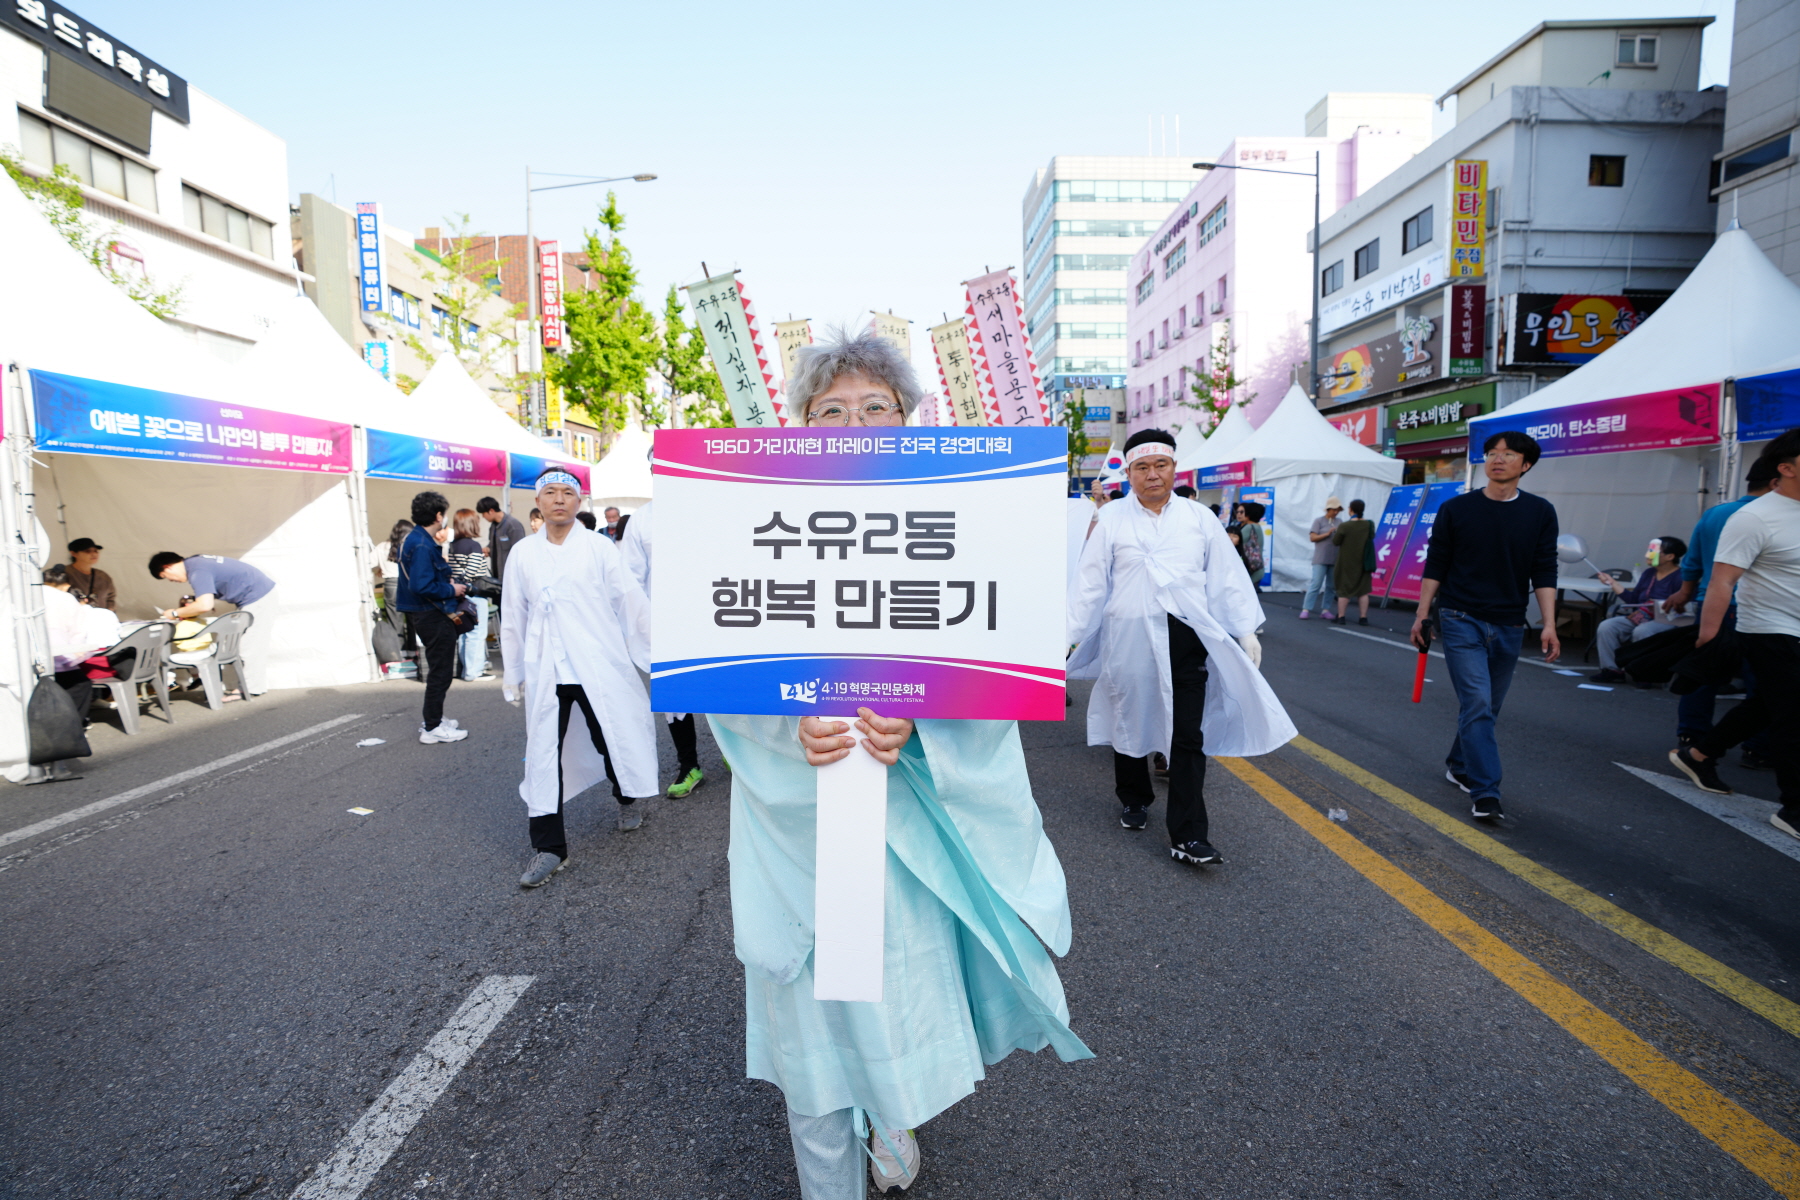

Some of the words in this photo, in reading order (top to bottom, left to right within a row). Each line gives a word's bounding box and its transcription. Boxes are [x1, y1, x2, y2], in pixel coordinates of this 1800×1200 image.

[1457, 163, 1482, 245] 비타민
[1454, 248, 1480, 263] 주점
[696, 287, 738, 313] 수유2동
[975, 282, 1010, 306] 수유2동
[1352, 290, 1374, 317] 수유
[1523, 310, 1605, 347] 무인도
[714, 311, 766, 428] 적십자봉
[986, 302, 1035, 427] 새마을문고
[947, 349, 981, 427] 통장협
[1397, 401, 1464, 430] 본죽&비빔밥
[1569, 415, 1627, 436] 탄소중립
[89, 408, 141, 437] 예쁜
[144, 415, 204, 442] 꽃으로
[205, 423, 258, 449] 나만의
[259, 430, 290, 452] 봉투
[291, 434, 333, 457] 만들자!
[704, 439, 749, 454] 1960
[753, 438, 822, 455] 거리재현
[826, 437, 896, 455] 퍼레이드
[900, 437, 936, 454] 전국
[939, 436, 1012, 455] 경연대회
[428, 455, 455, 472] 언제나
[1383, 512, 1412, 525] 화장실
[1420, 513, 1438, 524] 의료
[753, 510, 956, 561] 수유2동
[712, 577, 816, 629] 행복
[835, 579, 997, 631] 만들기
